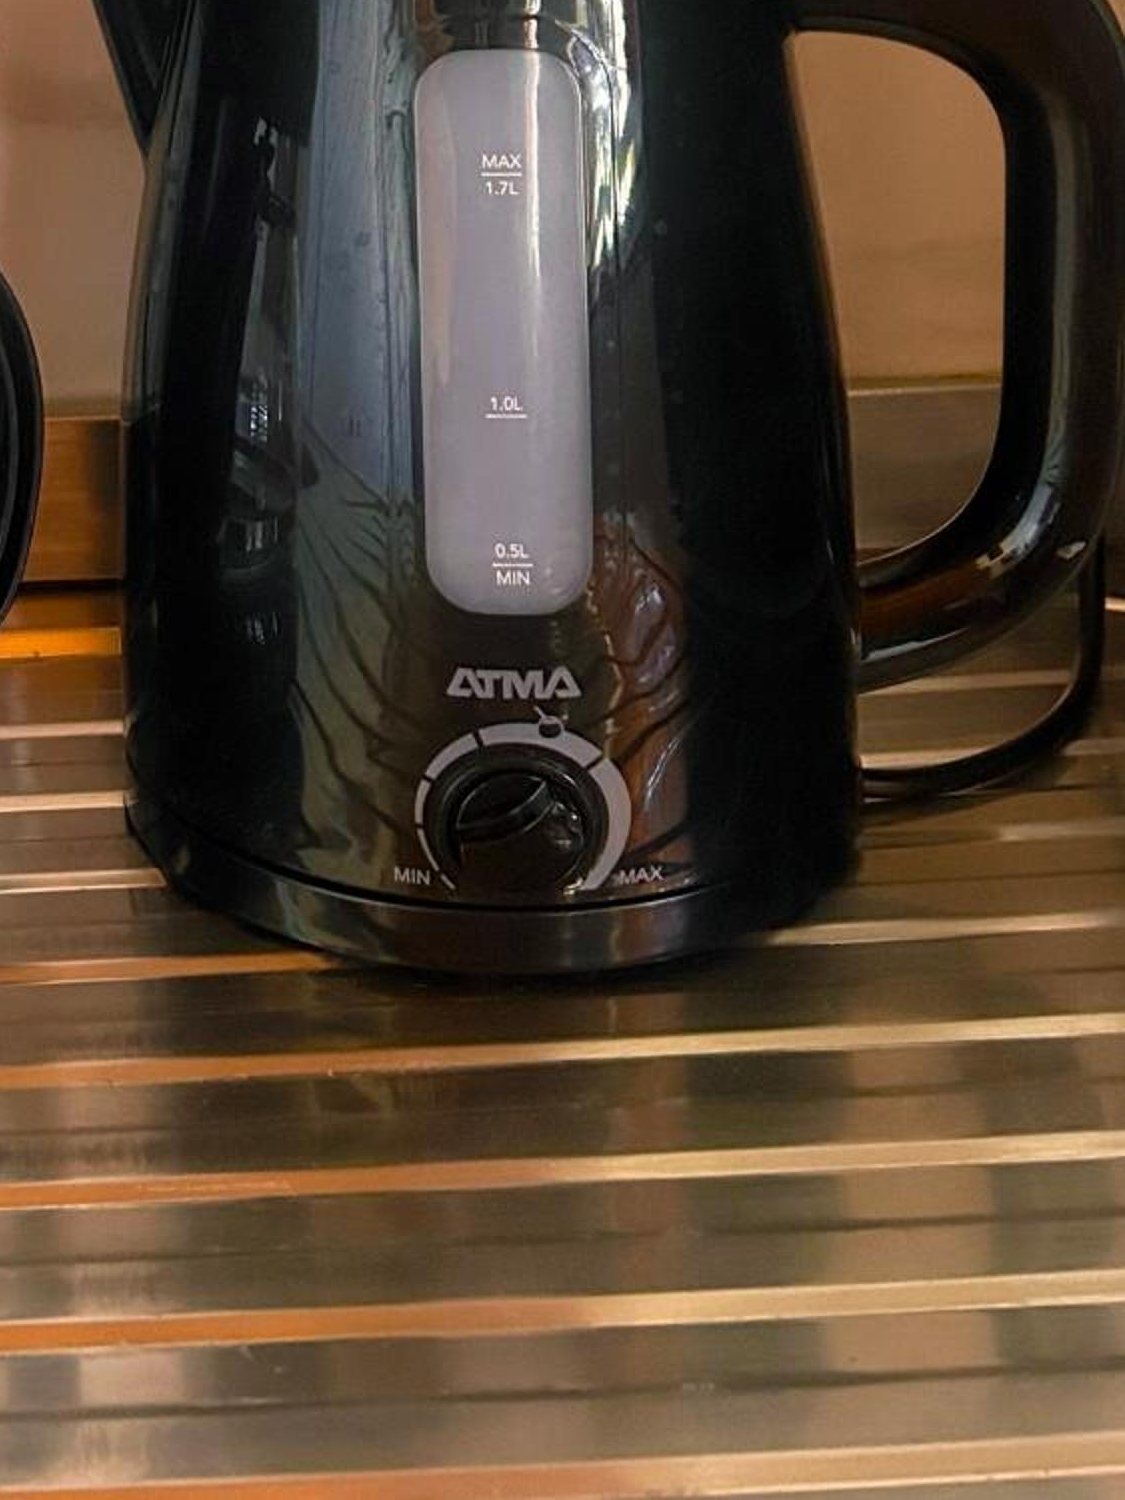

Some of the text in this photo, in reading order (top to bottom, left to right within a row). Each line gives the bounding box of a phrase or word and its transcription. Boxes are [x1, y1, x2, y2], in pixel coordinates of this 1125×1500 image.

[481, 153, 523, 168] MAX
[486, 181, 520, 195] 1.7L
[490, 396, 523, 411] 1.0L
[494, 542, 530, 559] 0.5L
[496, 569, 531, 586] MIN
[446, 666, 582, 700] ATMA
[393, 866, 431, 886] MIN
[618, 865, 665, 886] MAX
